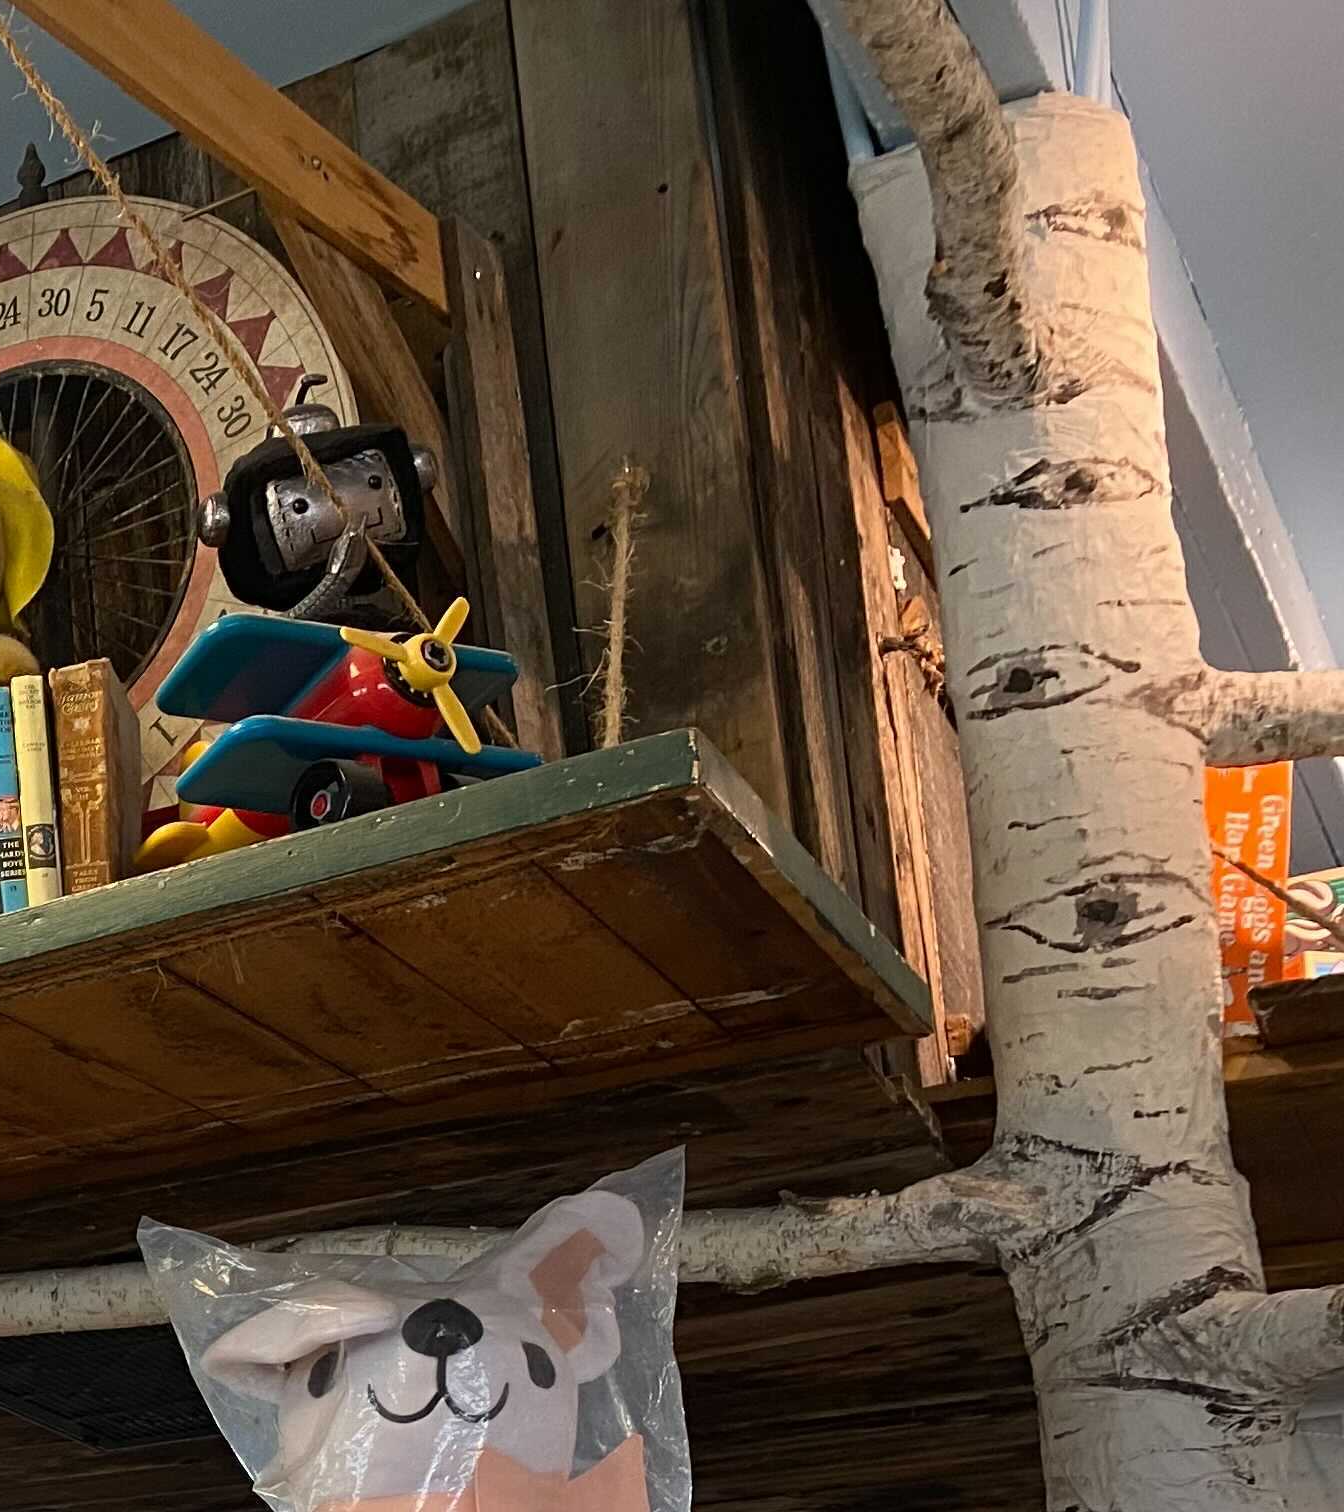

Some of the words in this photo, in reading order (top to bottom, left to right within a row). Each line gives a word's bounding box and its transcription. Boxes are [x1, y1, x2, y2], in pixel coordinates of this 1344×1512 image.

[37, 288, 71, 318] 30
[85, 288, 106, 322] 5
[121, 299, 148, 338] 11
[157, 321, 200, 362] 17
[188, 350, 230, 396] 24
[214, 395, 253, 438] 30
